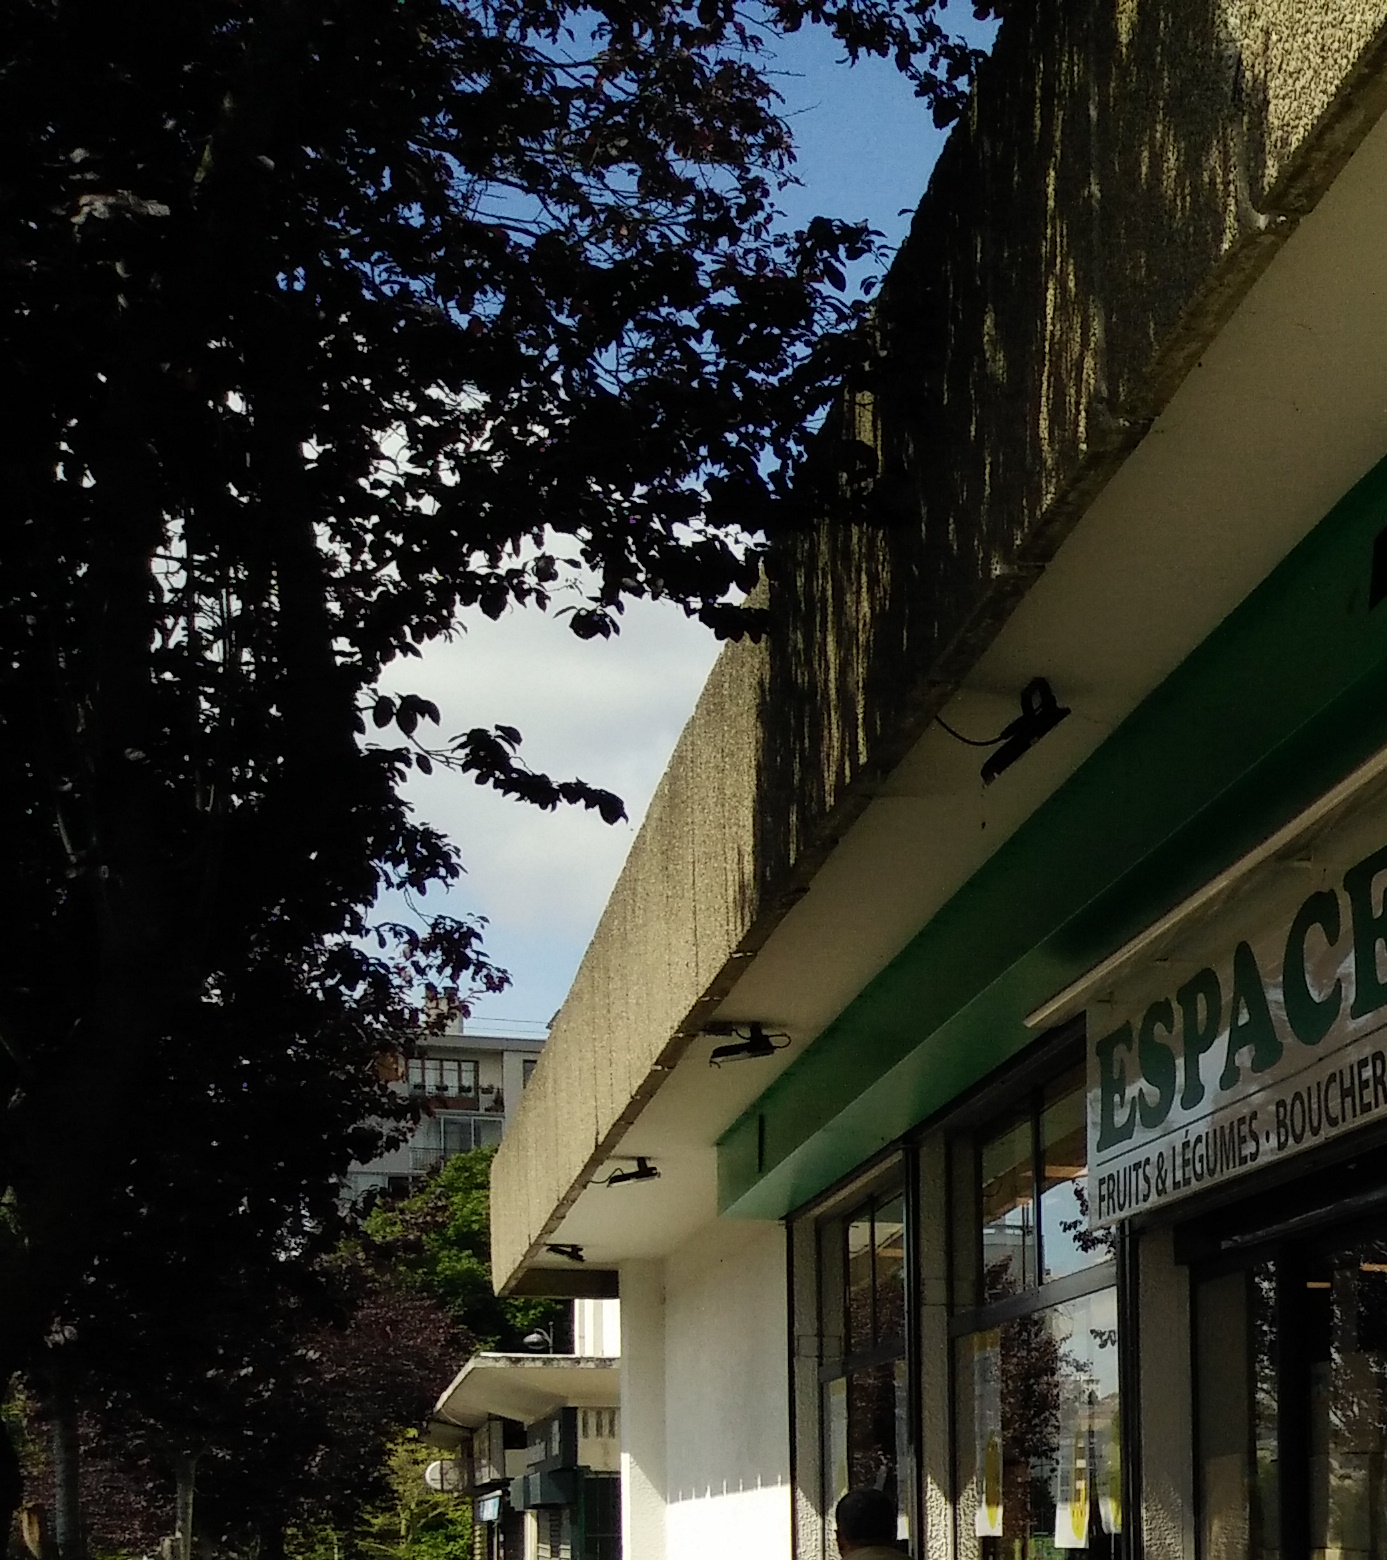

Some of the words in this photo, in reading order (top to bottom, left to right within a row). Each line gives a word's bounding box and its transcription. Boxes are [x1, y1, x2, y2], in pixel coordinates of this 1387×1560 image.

[1098, 1155, 1151, 1220] FRUITS
[1155, 1151, 1168, 1196] &
[1172, 1111, 1260, 1190] LÉGUMES
